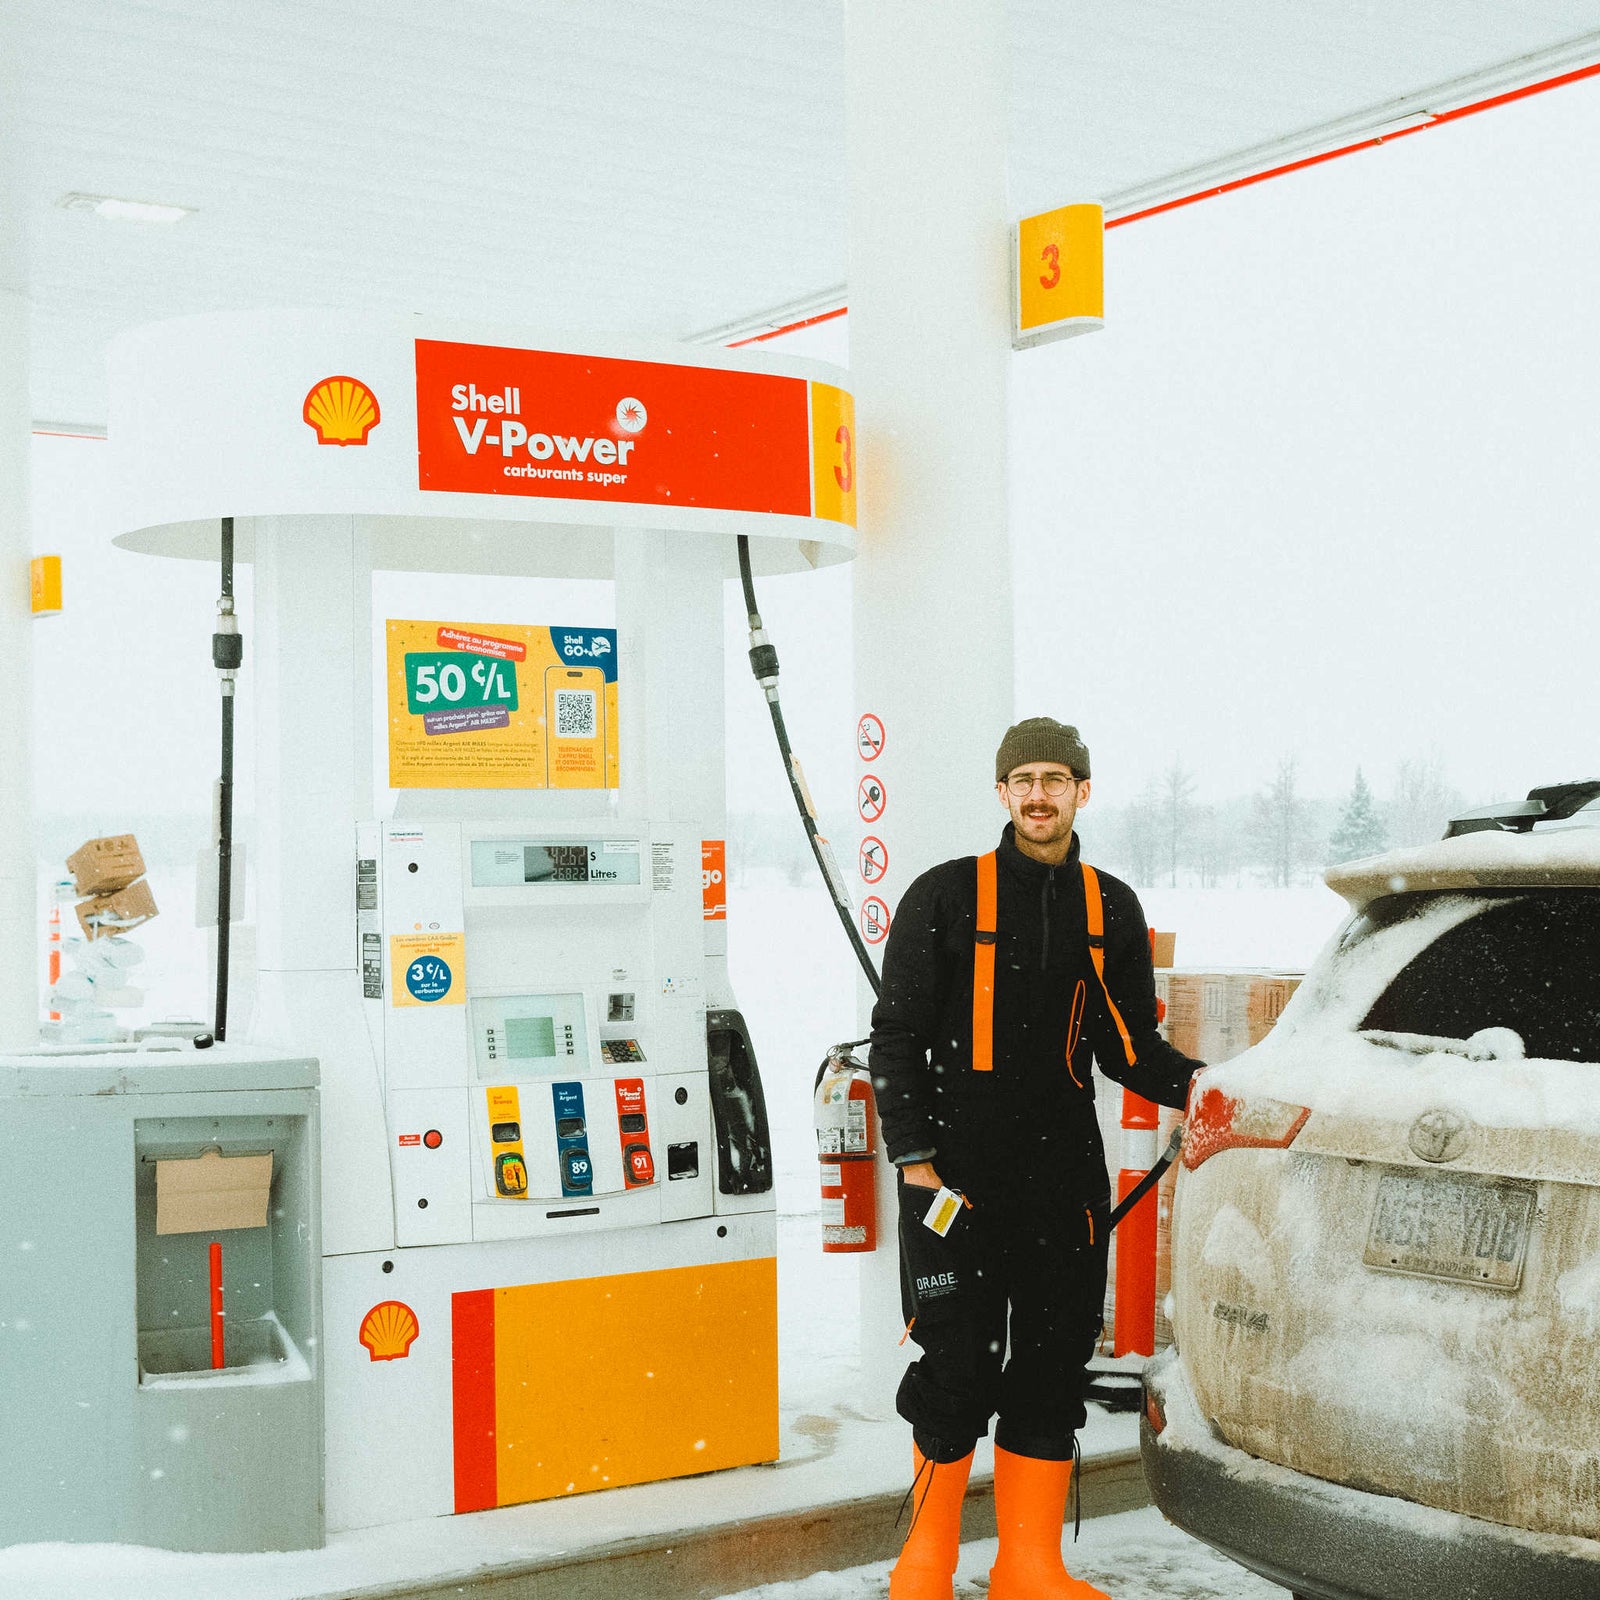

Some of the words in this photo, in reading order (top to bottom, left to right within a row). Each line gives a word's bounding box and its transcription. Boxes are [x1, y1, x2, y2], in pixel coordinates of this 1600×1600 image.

[1040, 244, 1060, 289] 3
[451, 384, 521, 414] Shell
[452, 416, 634, 465] V-Power
[834, 425, 852, 492] 3
[504, 464, 584, 480] carburants
[587, 472, 628, 486] super
[441, 630, 471, 642] Adhérez
[482, 640, 524, 652] programme
[466, 644, 506, 657] économisez
[564, 635, 584, 644] Shell
[416, 664, 466, 703] 50
[471, 660, 512, 700] ¢/L
[590, 869, 617, 878] Litres
[412, 964, 424, 981] 3
[572, 1161, 588, 1174] 89
[634, 1157, 648, 1168] 91
